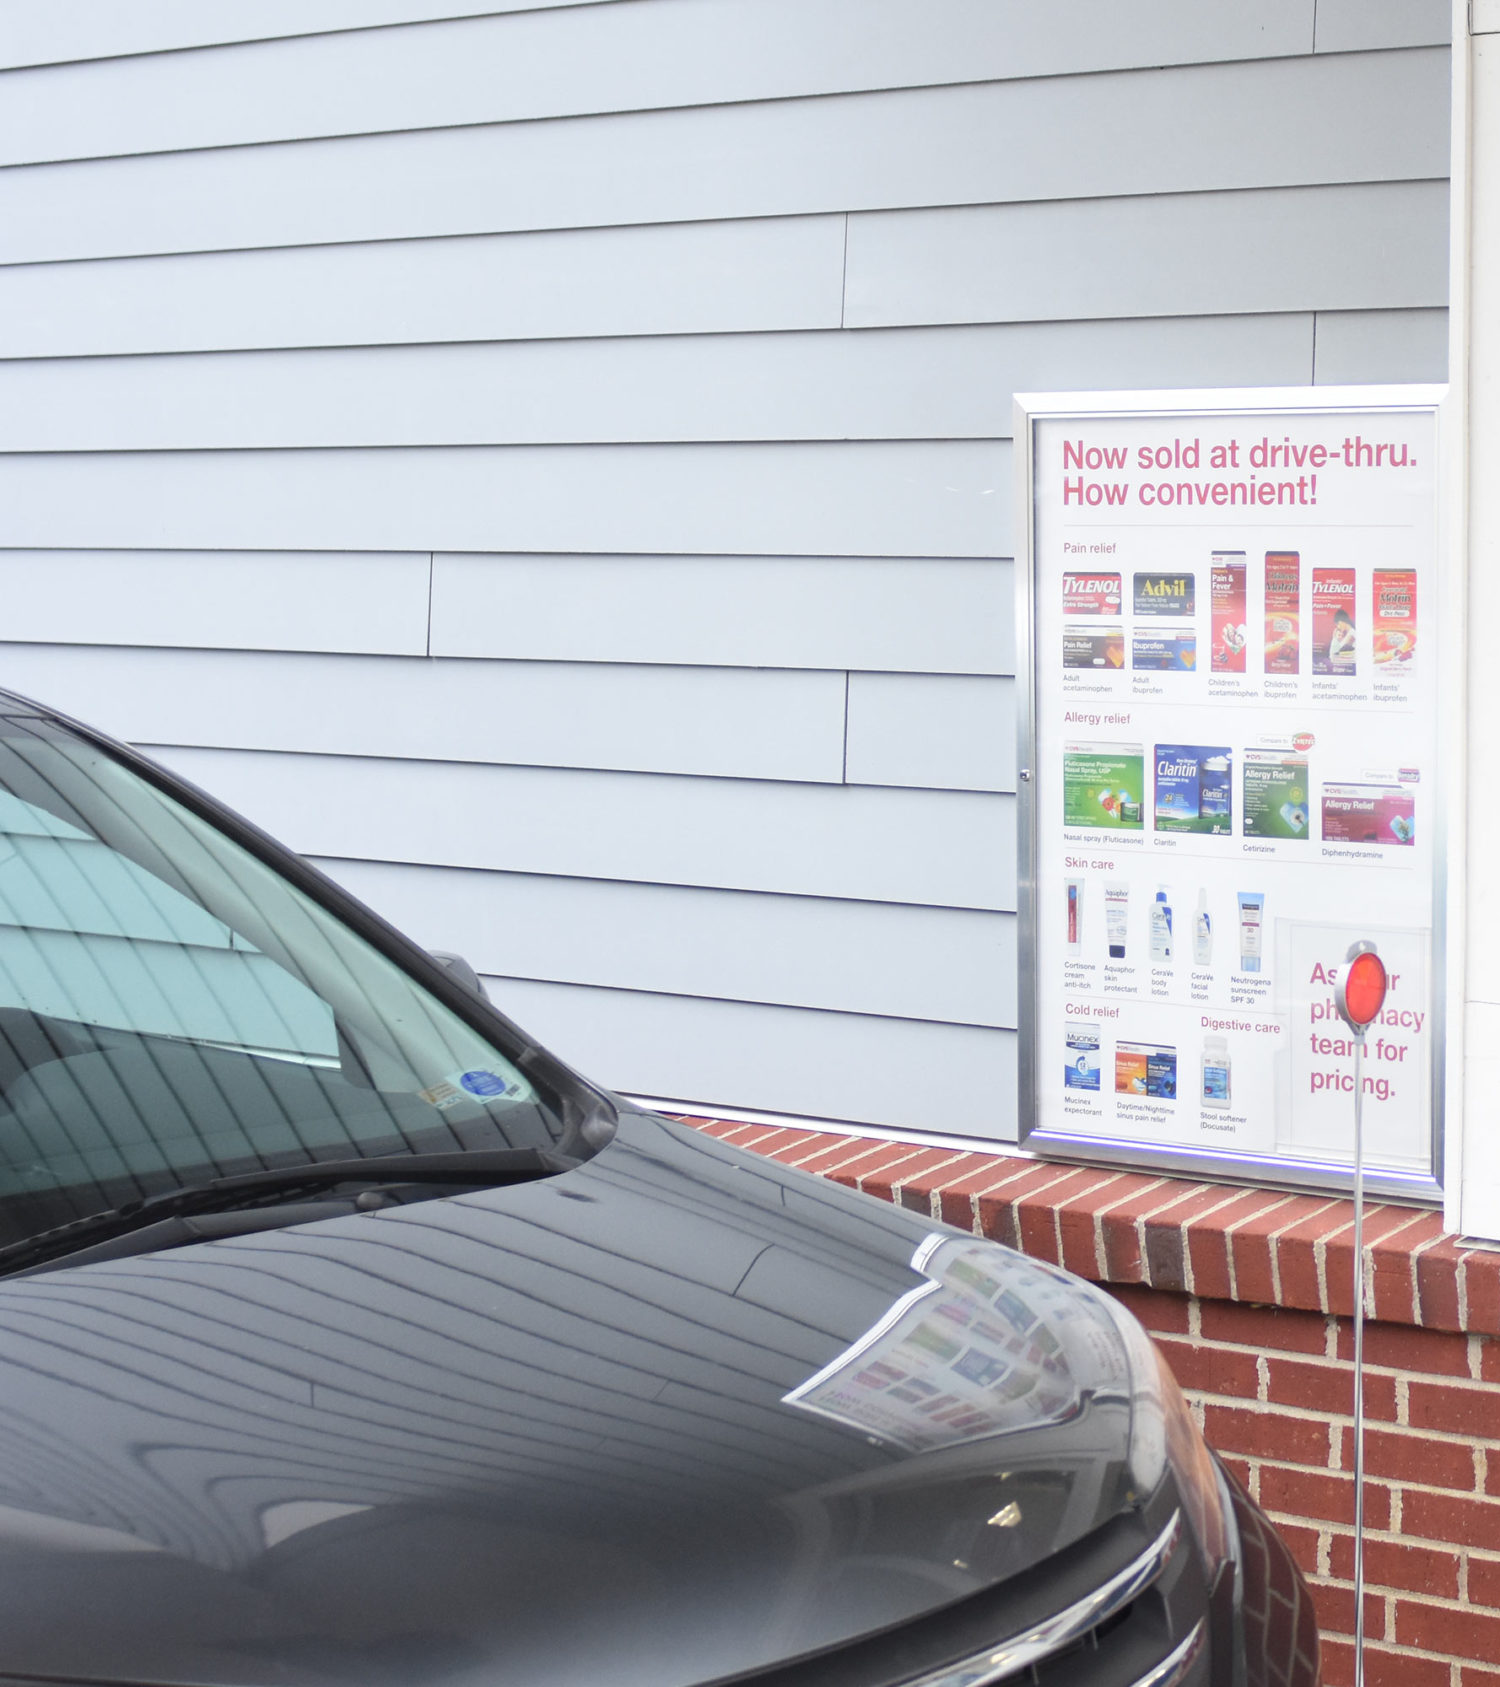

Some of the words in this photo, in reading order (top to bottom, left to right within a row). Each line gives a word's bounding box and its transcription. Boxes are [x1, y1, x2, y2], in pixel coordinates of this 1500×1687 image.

[1063, 440, 1128, 469] Now
[1138, 438, 1200, 469] sold
[1210, 441, 1239, 468] at
[1249, 436, 1417, 468] drive-thru.
[1063, 476, 1129, 506] How
[1138, 474, 1317, 505] convenient!
[1063, 543, 1087, 554] Pain
[1090, 542, 1116, 554] relief
[1141, 580, 1187, 596] Advil
[1063, 674, 1080, 682] Adult
[1133, 676, 1149, 684] Adult
[1208, 679, 1240, 687] Children's
[1264, 680, 1298, 689] Children's
[1063, 685, 1112, 694] acetaminophen
[1133, 686, 1163, 694] ibuprofen
[1208, 688, 1258, 698] acetaminophen
[1264, 691, 1297, 700] ibuprofen
[1312, 692, 1367, 701] acetaminophen
[1373, 694, 1407, 702] ibuprofen
[1064, 712, 1101, 726] Allergy
[1104, 713, 1131, 724] relief
[1158, 760, 1197, 777] Claritin
[1245, 770, 1270, 780] Allergy
[1273, 771, 1295, 780] Relief
[1064, 834, 1082, 842] Nasal
[1084, 835, 1101, 843] spray
[1103, 835, 1144, 846] (Fluticasone)
[1243, 844, 1276, 853] Cetirizine
[1322, 848, 1383, 859] Diphenhydramine
[1065, 857, 1088, 868] Skin
[1091, 860, 1114, 870] care
[1065, 962, 1096, 970] Cortisone
[1104, 965, 1135, 974] Aquaphor
[1152, 968, 1174, 977] CeraVe
[1191, 973, 1214, 981] CeraVe
[1310, 962, 1338, 985] As
[1104, 974, 1117, 982] skin
[1231, 976, 1272, 986] Neutrogena
[1065, 981, 1091, 989] anti-itch
[1152, 979, 1166, 987] body
[1191, 982, 1208, 990] facial
[1104, 984, 1137, 994] protectant
[1152, 988, 1169, 996] lotion
[1231, 987, 1266, 996] sunscreen
[1191, 992, 1209, 1000] lotion
[1231, 996, 1244, 1004] SPF
[1065, 1004, 1090, 1016] Cold
[1093, 1006, 1120, 1018] relief
[1311, 999, 1424, 1033] phacy
[1201, 1016, 1251, 1031] Digestive
[1255, 1023, 1280, 1033] care
[1067, 1033, 1099, 1042] Mucinex
[1376, 1039, 1408, 1062] for
[1310, 1069, 1395, 1101] pricng.
[1065, 1096, 1091, 1105] Mucinex
[1065, 1107, 1102, 1116] expectorant
[1117, 1102, 1175, 1114] Daytime/Nighttime
[1117, 1112, 1133, 1120] sinus
[1135, 1114, 1149, 1122] pain
[1150, 1115, 1166, 1123] relief
[1200, 1112, 1218, 1120] Stool
[1219, 1114, 1247, 1123] softener
[1200, 1122, 1236, 1132] (Docusate)
